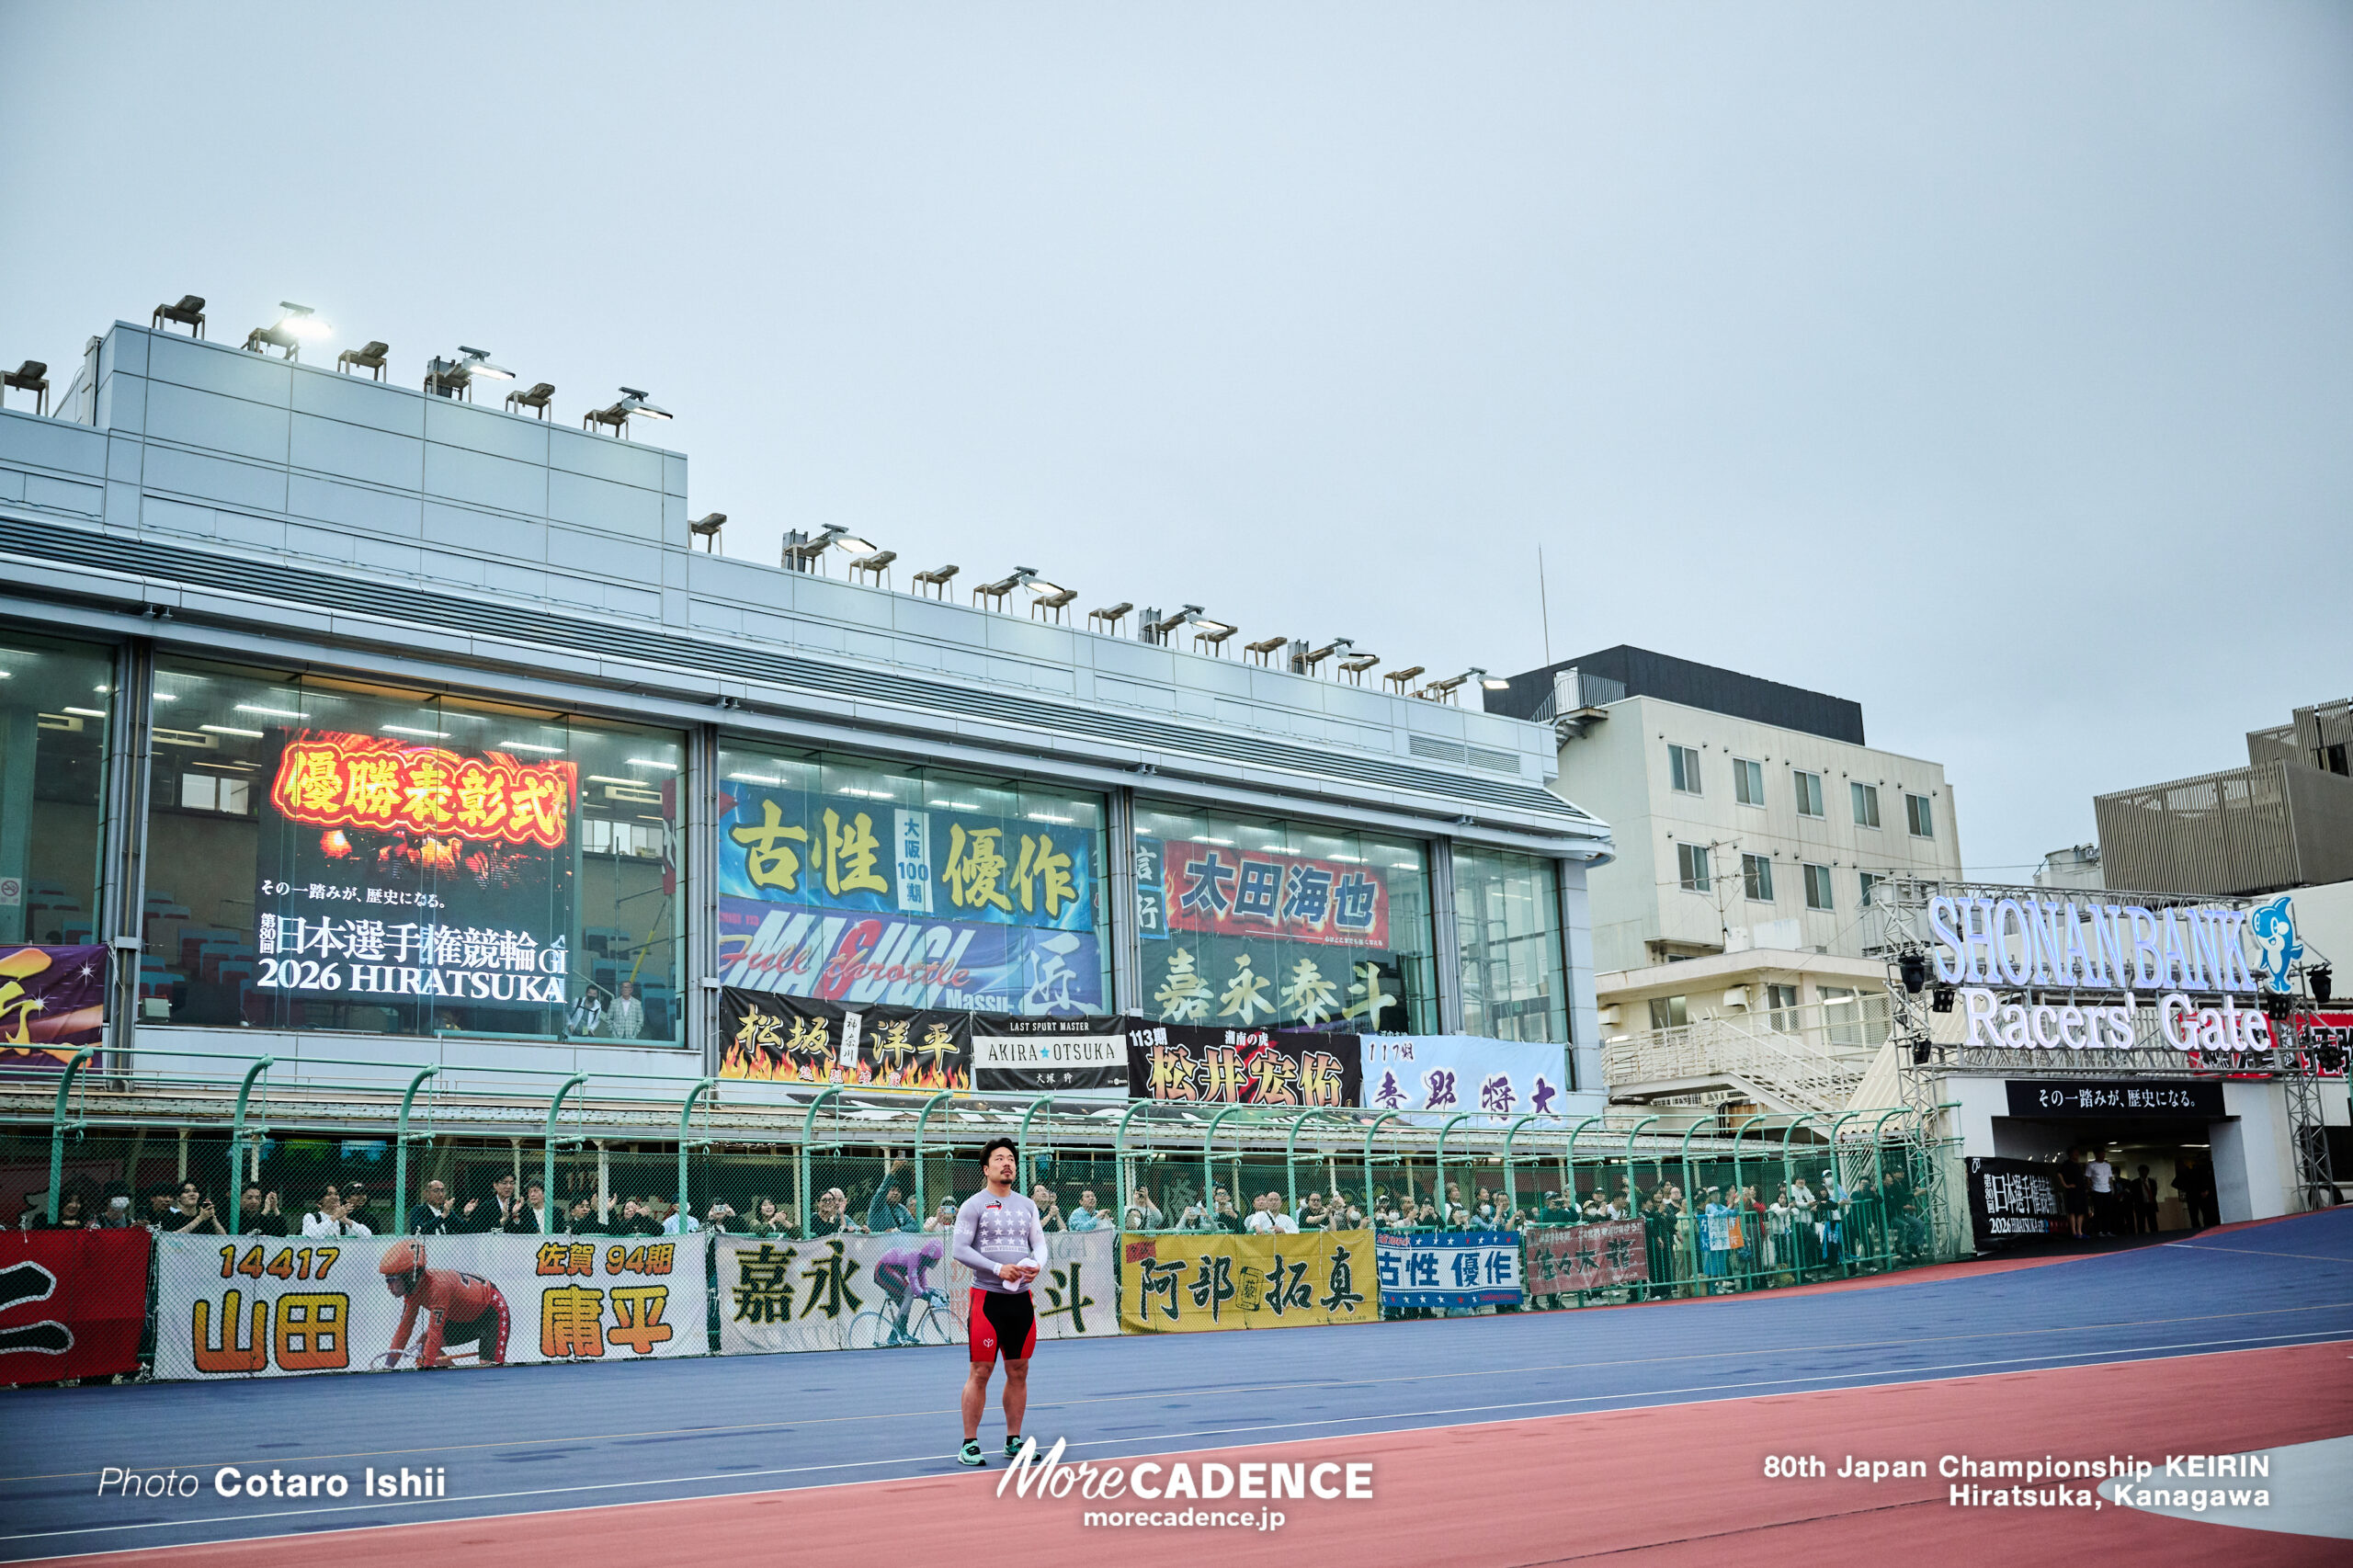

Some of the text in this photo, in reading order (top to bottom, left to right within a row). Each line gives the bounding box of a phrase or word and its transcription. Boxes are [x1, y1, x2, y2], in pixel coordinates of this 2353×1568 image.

[285, 750, 557, 837] 優勝表彰式
[733, 799, 889, 897] 古性
[943, 823, 1080, 917] 優作
[897, 817, 929, 904] 大阪100期
[261, 879, 446, 909] その一踏みが、歴史になる。
[1180, 849, 1381, 930] 太田海也
[258, 913, 277, 956] 第80回
[276, 915, 539, 972] 日本選手権競輪
[1928, 895, 2259, 993] SHONAN BANK
[256, 958, 568, 1005] 2026 HIRATSUKA
[825, 949, 973, 988] throttle
[1154, 947, 1398, 1031] 嘉永泰斗
[735, 1002, 961, 1074] 松坂 洋平
[843, 1017, 858, 1063] 神奈川
[1010, 1021, 1089, 1032] LAST SPURT MASTER
[1129, 1027, 1168, 1048] 113期
[1224, 1029, 1269, 1047] 湘南の虎
[1959, 986, 2138, 1051] Racers'
[2159, 993, 2271, 1053] Gate
[988, 1042, 1116, 1062] AKIRA OTSUKA
[1146, 1044, 1345, 1108] 松井宏佑
[2038, 1087, 2197, 1108] その一踏みが、歴史になる。
[1989, 1217, 2012, 1234] 2026
[220, 1243, 341, 1281] 14417
[536, 1242, 676, 1277] 佐賀 94期
[733, 1239, 863, 1324] 嘉永
[1140, 1244, 1365, 1324] 阿部 拓真
[192, 1283, 674, 1374] 山田 庸平
